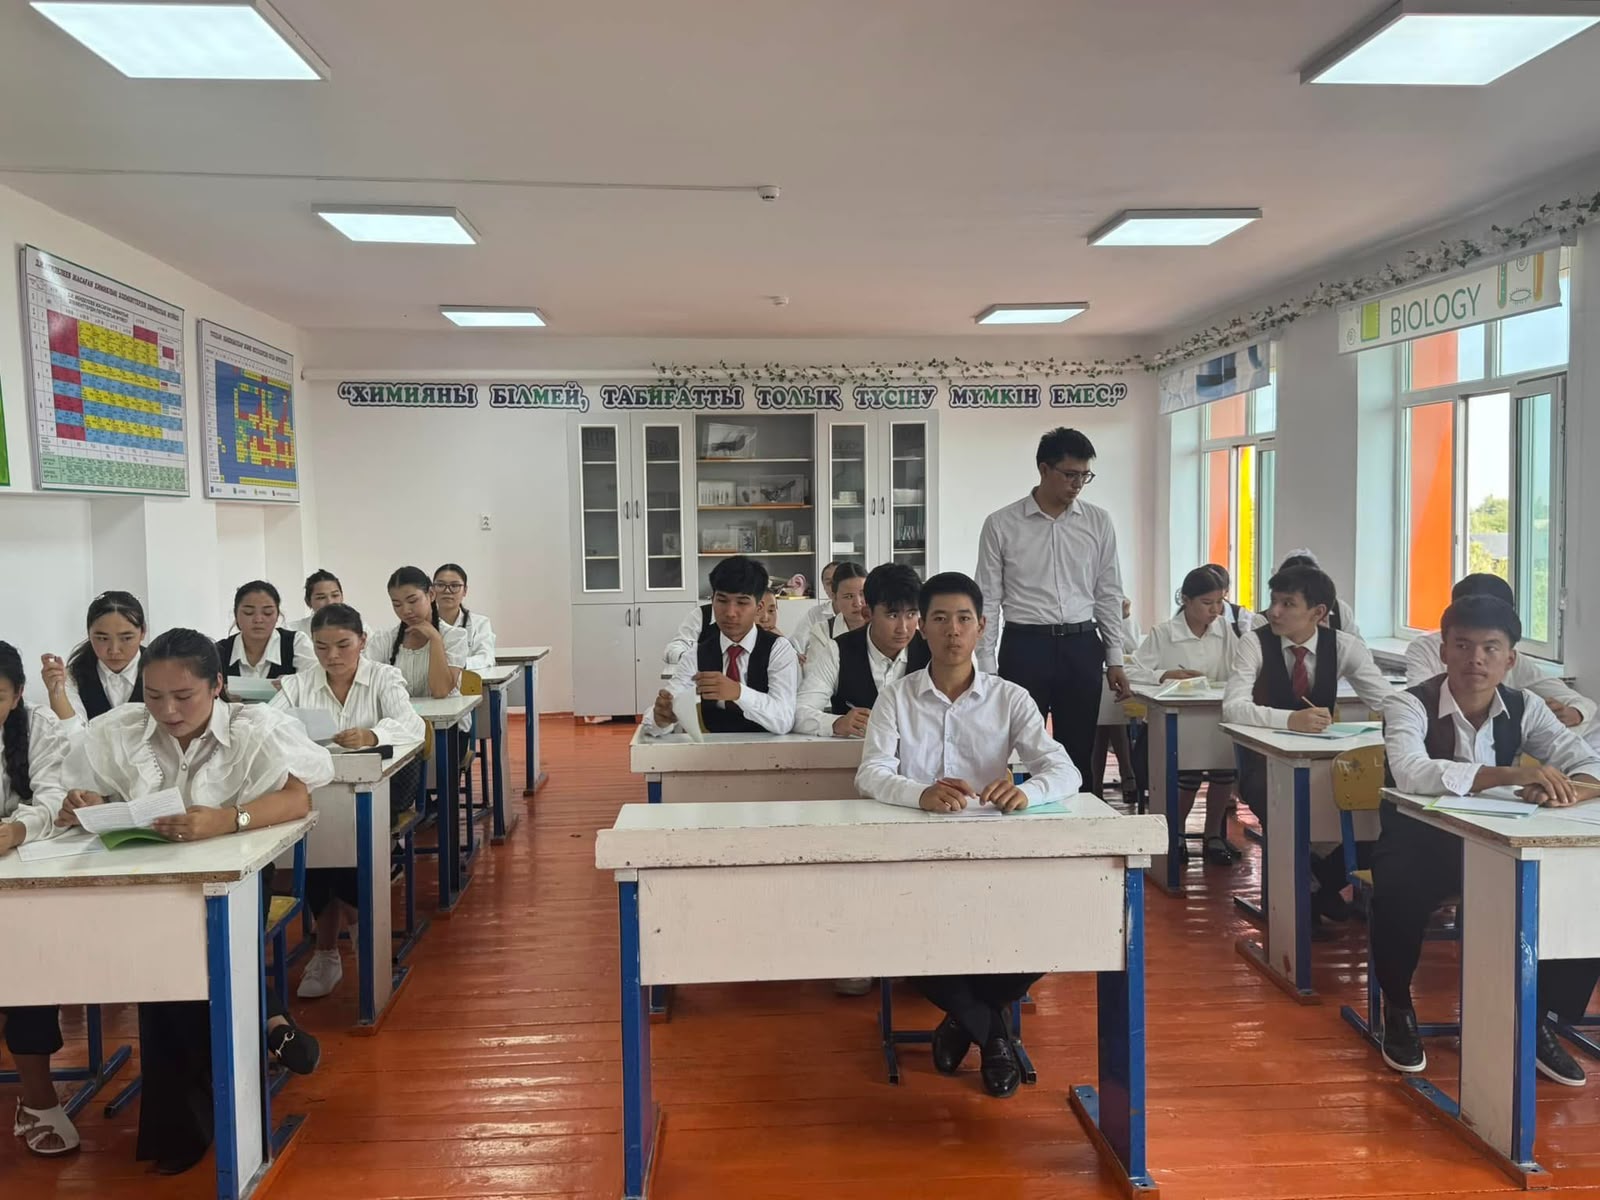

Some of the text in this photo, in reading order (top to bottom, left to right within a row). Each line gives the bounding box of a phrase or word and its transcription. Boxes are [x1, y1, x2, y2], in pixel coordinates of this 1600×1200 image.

[1390, 283, 1482, 336] BIOLOGY
[491, 383, 587, 410] БІЛМЕЙ,
[602, 387, 742, 406] ТАБИҒАТТЫ
[757, 387, 841, 409] ТОЛЫҚ
[855, 388, 936, 406] ТҮСІНУ
[951, 387, 1039, 405] МҮМКІН
